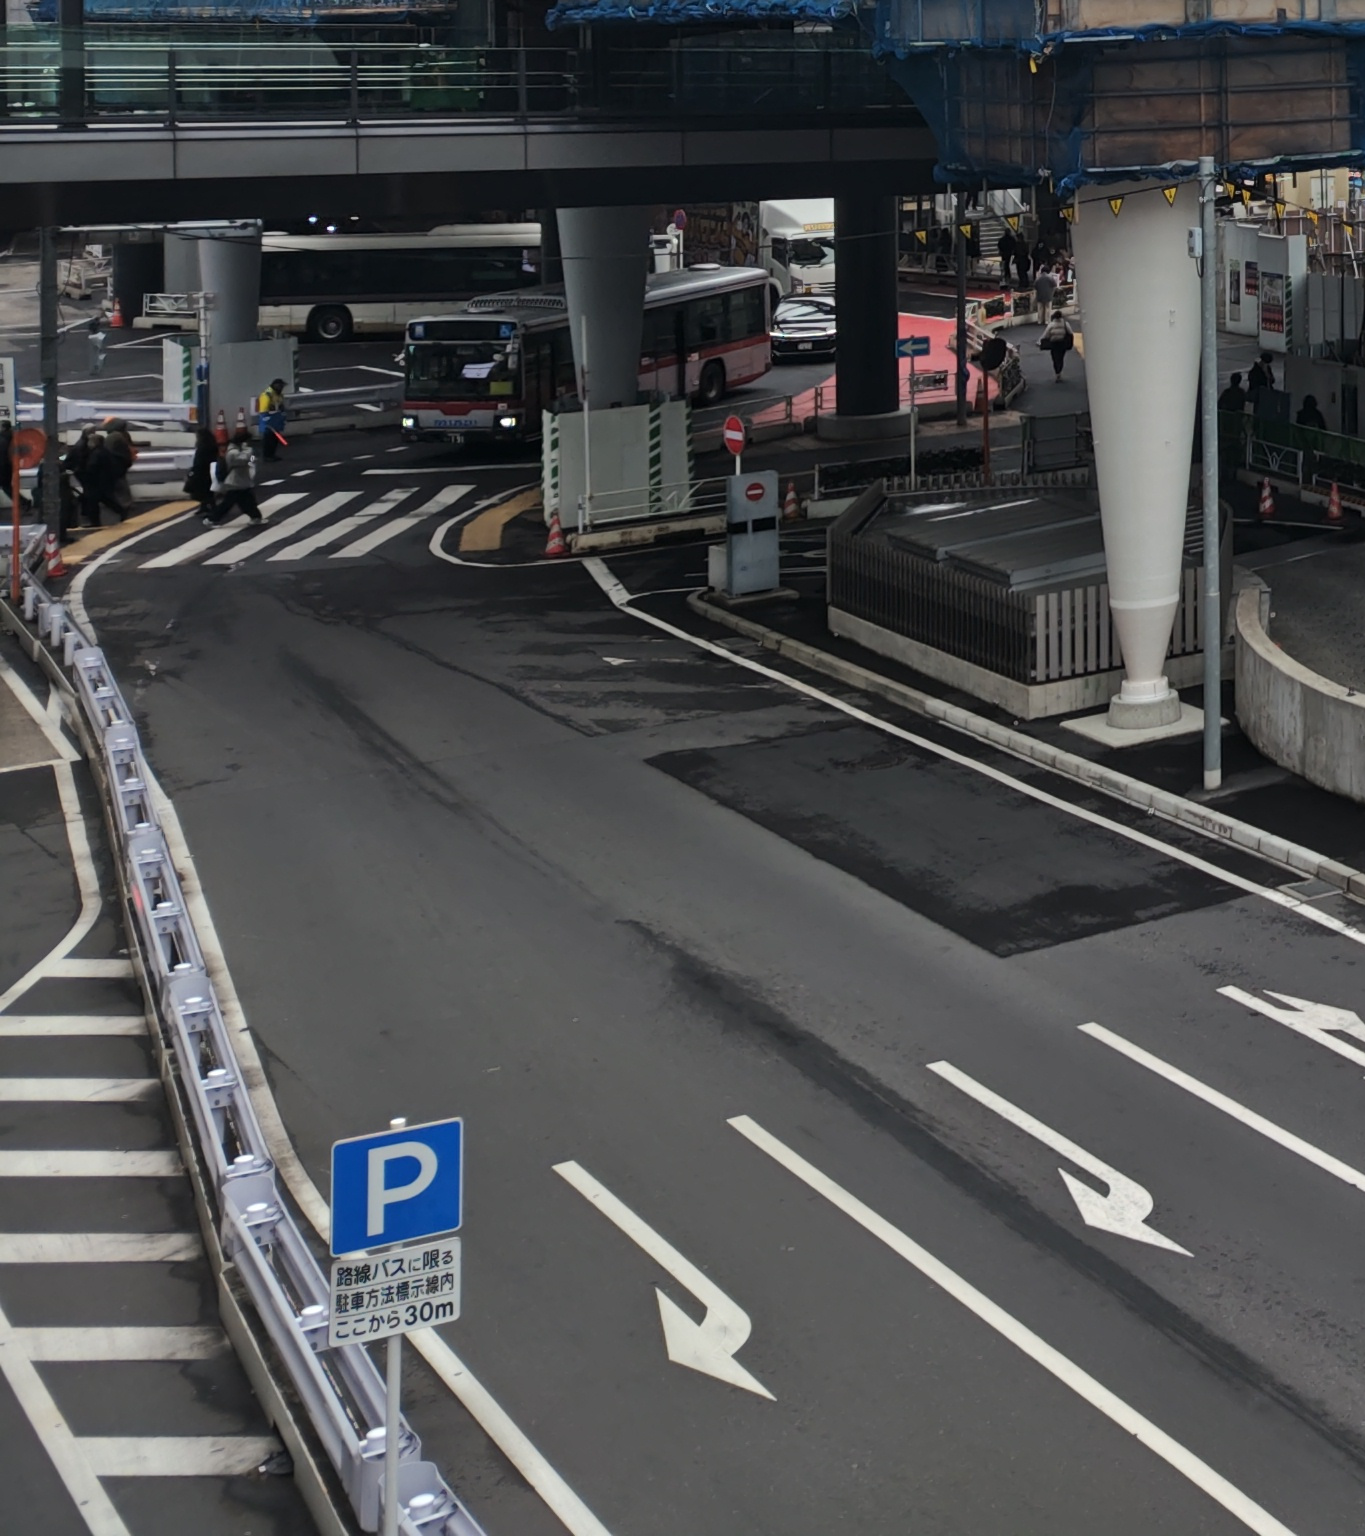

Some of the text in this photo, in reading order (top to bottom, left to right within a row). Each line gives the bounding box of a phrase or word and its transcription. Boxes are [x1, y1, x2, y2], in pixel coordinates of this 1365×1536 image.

[367, 1141, 438, 1238] P
[336, 1249, 454, 1288] 路線バスに限る
[336, 1272, 454, 1314] 駐車方法標示線内
[336, 1301, 454, 1339] ここから30m
